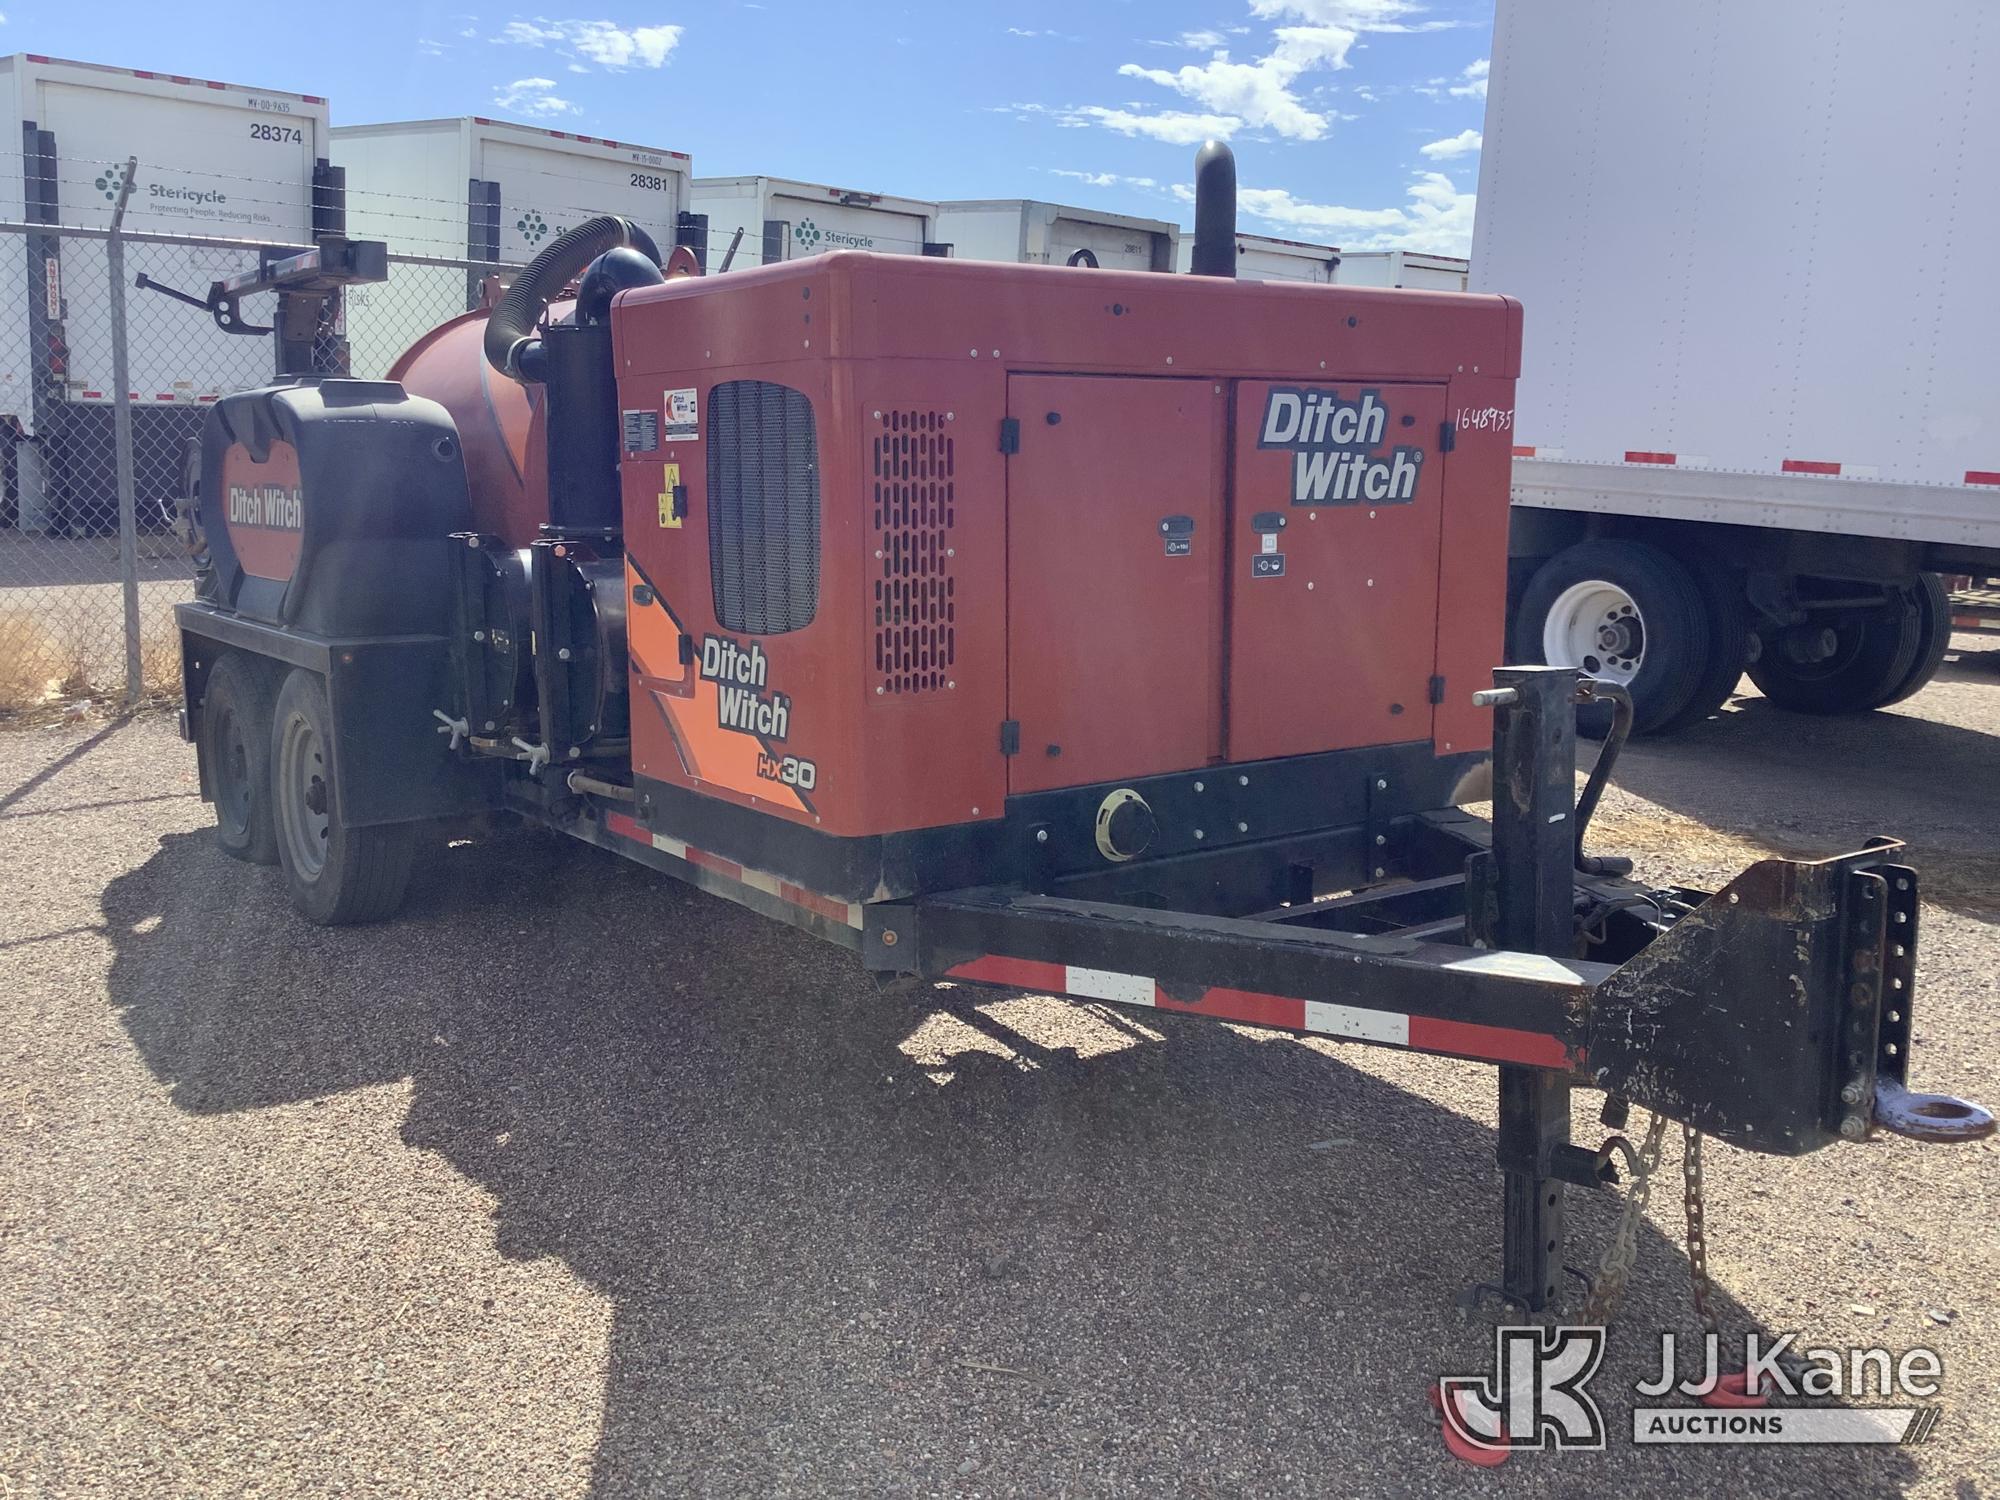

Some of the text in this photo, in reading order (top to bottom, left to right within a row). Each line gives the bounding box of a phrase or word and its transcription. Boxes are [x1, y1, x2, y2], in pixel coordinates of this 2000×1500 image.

[250, 123, 303, 145] 28374
[149, 184, 227, 205] Stericycle
[630, 173, 668, 192] 28381
[149, 203, 189, 216] Protecting
[218, 210, 252, 224] Reducing
[824, 229, 874, 249] Stericycle
[49, 260, 57, 314] ANTHONY
[1263, 393, 1385, 444] Ditch
[1455, 407, 1514, 432] 1648935
[230, 487, 261, 525] Ditch
[702, 637, 767, 687] Ditch
[758, 757, 816, 790] HX30
